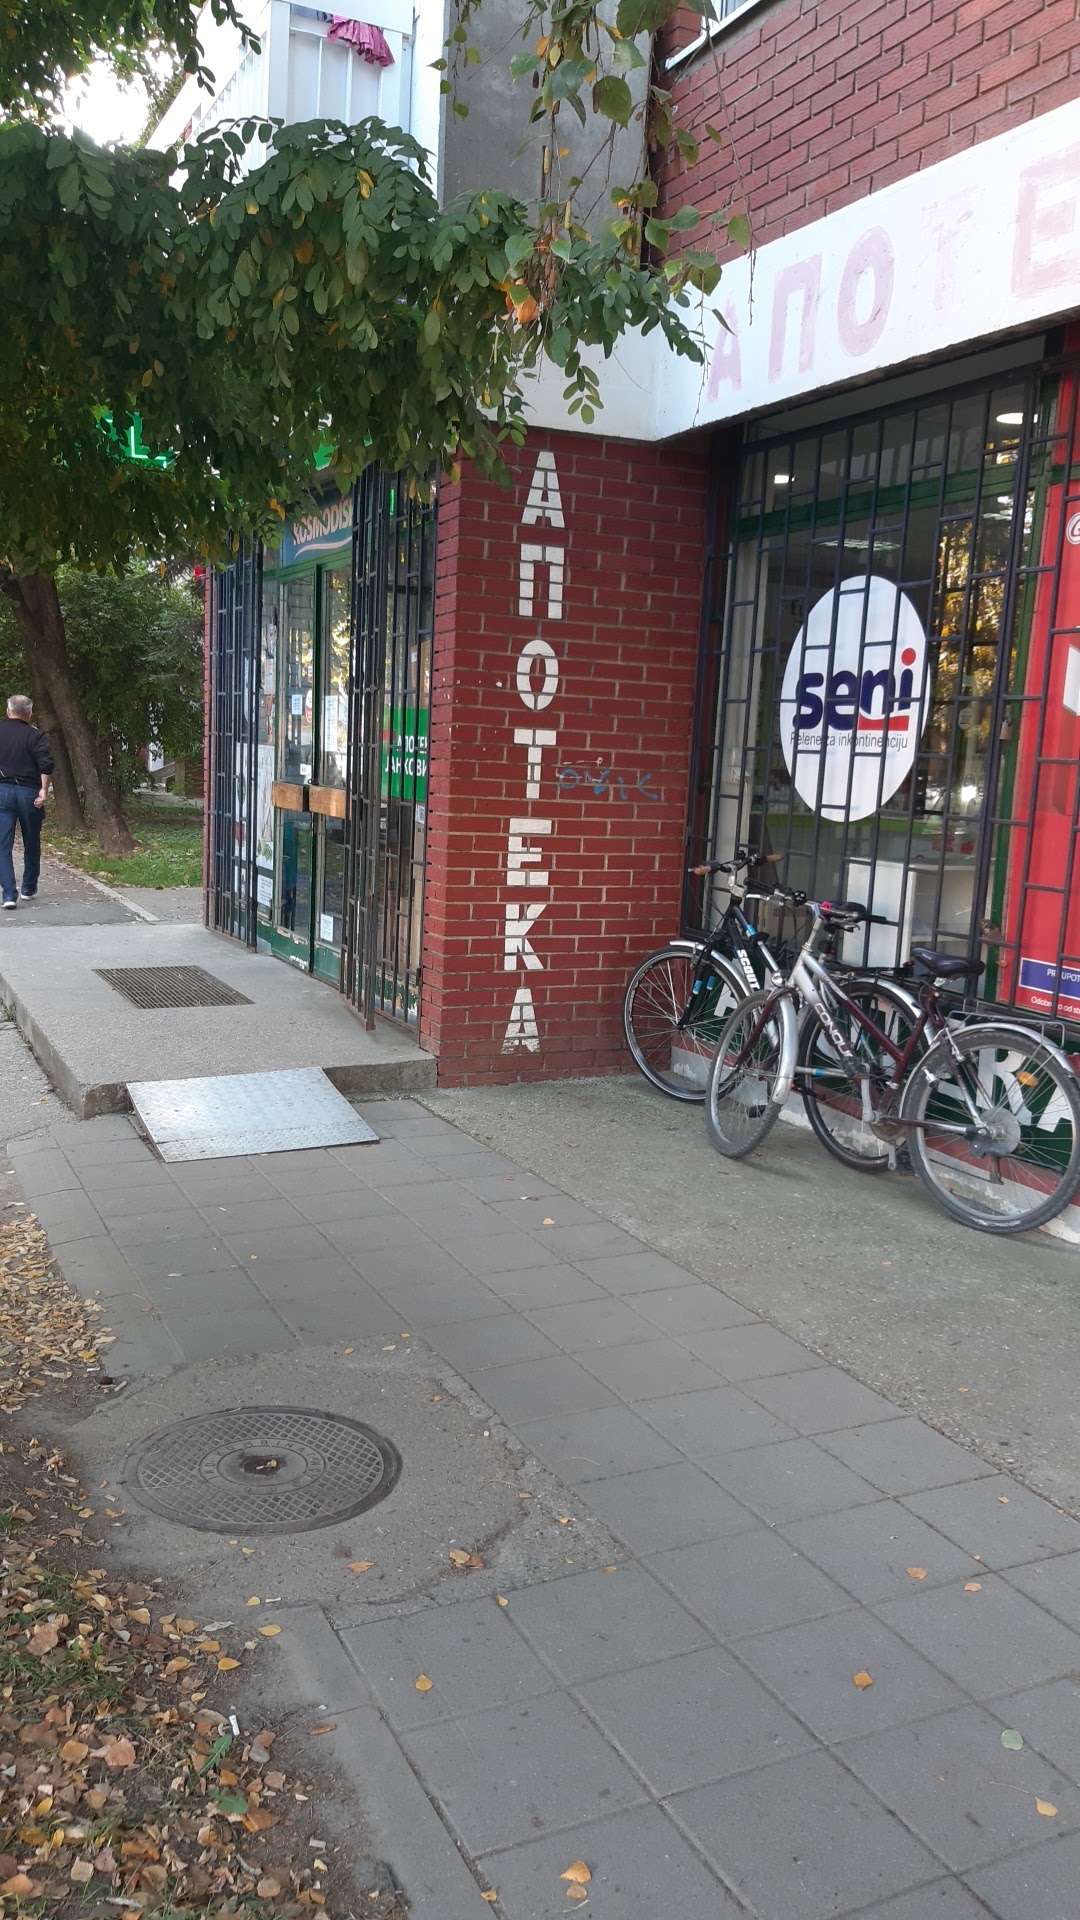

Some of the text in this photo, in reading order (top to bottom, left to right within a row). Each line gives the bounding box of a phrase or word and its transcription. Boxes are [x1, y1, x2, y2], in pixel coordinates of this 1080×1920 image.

[792, 647, 916, 731] seni
[500, 451, 565, 1055] АПОТЕКА
[737, 949, 760, 990] SCOUT
